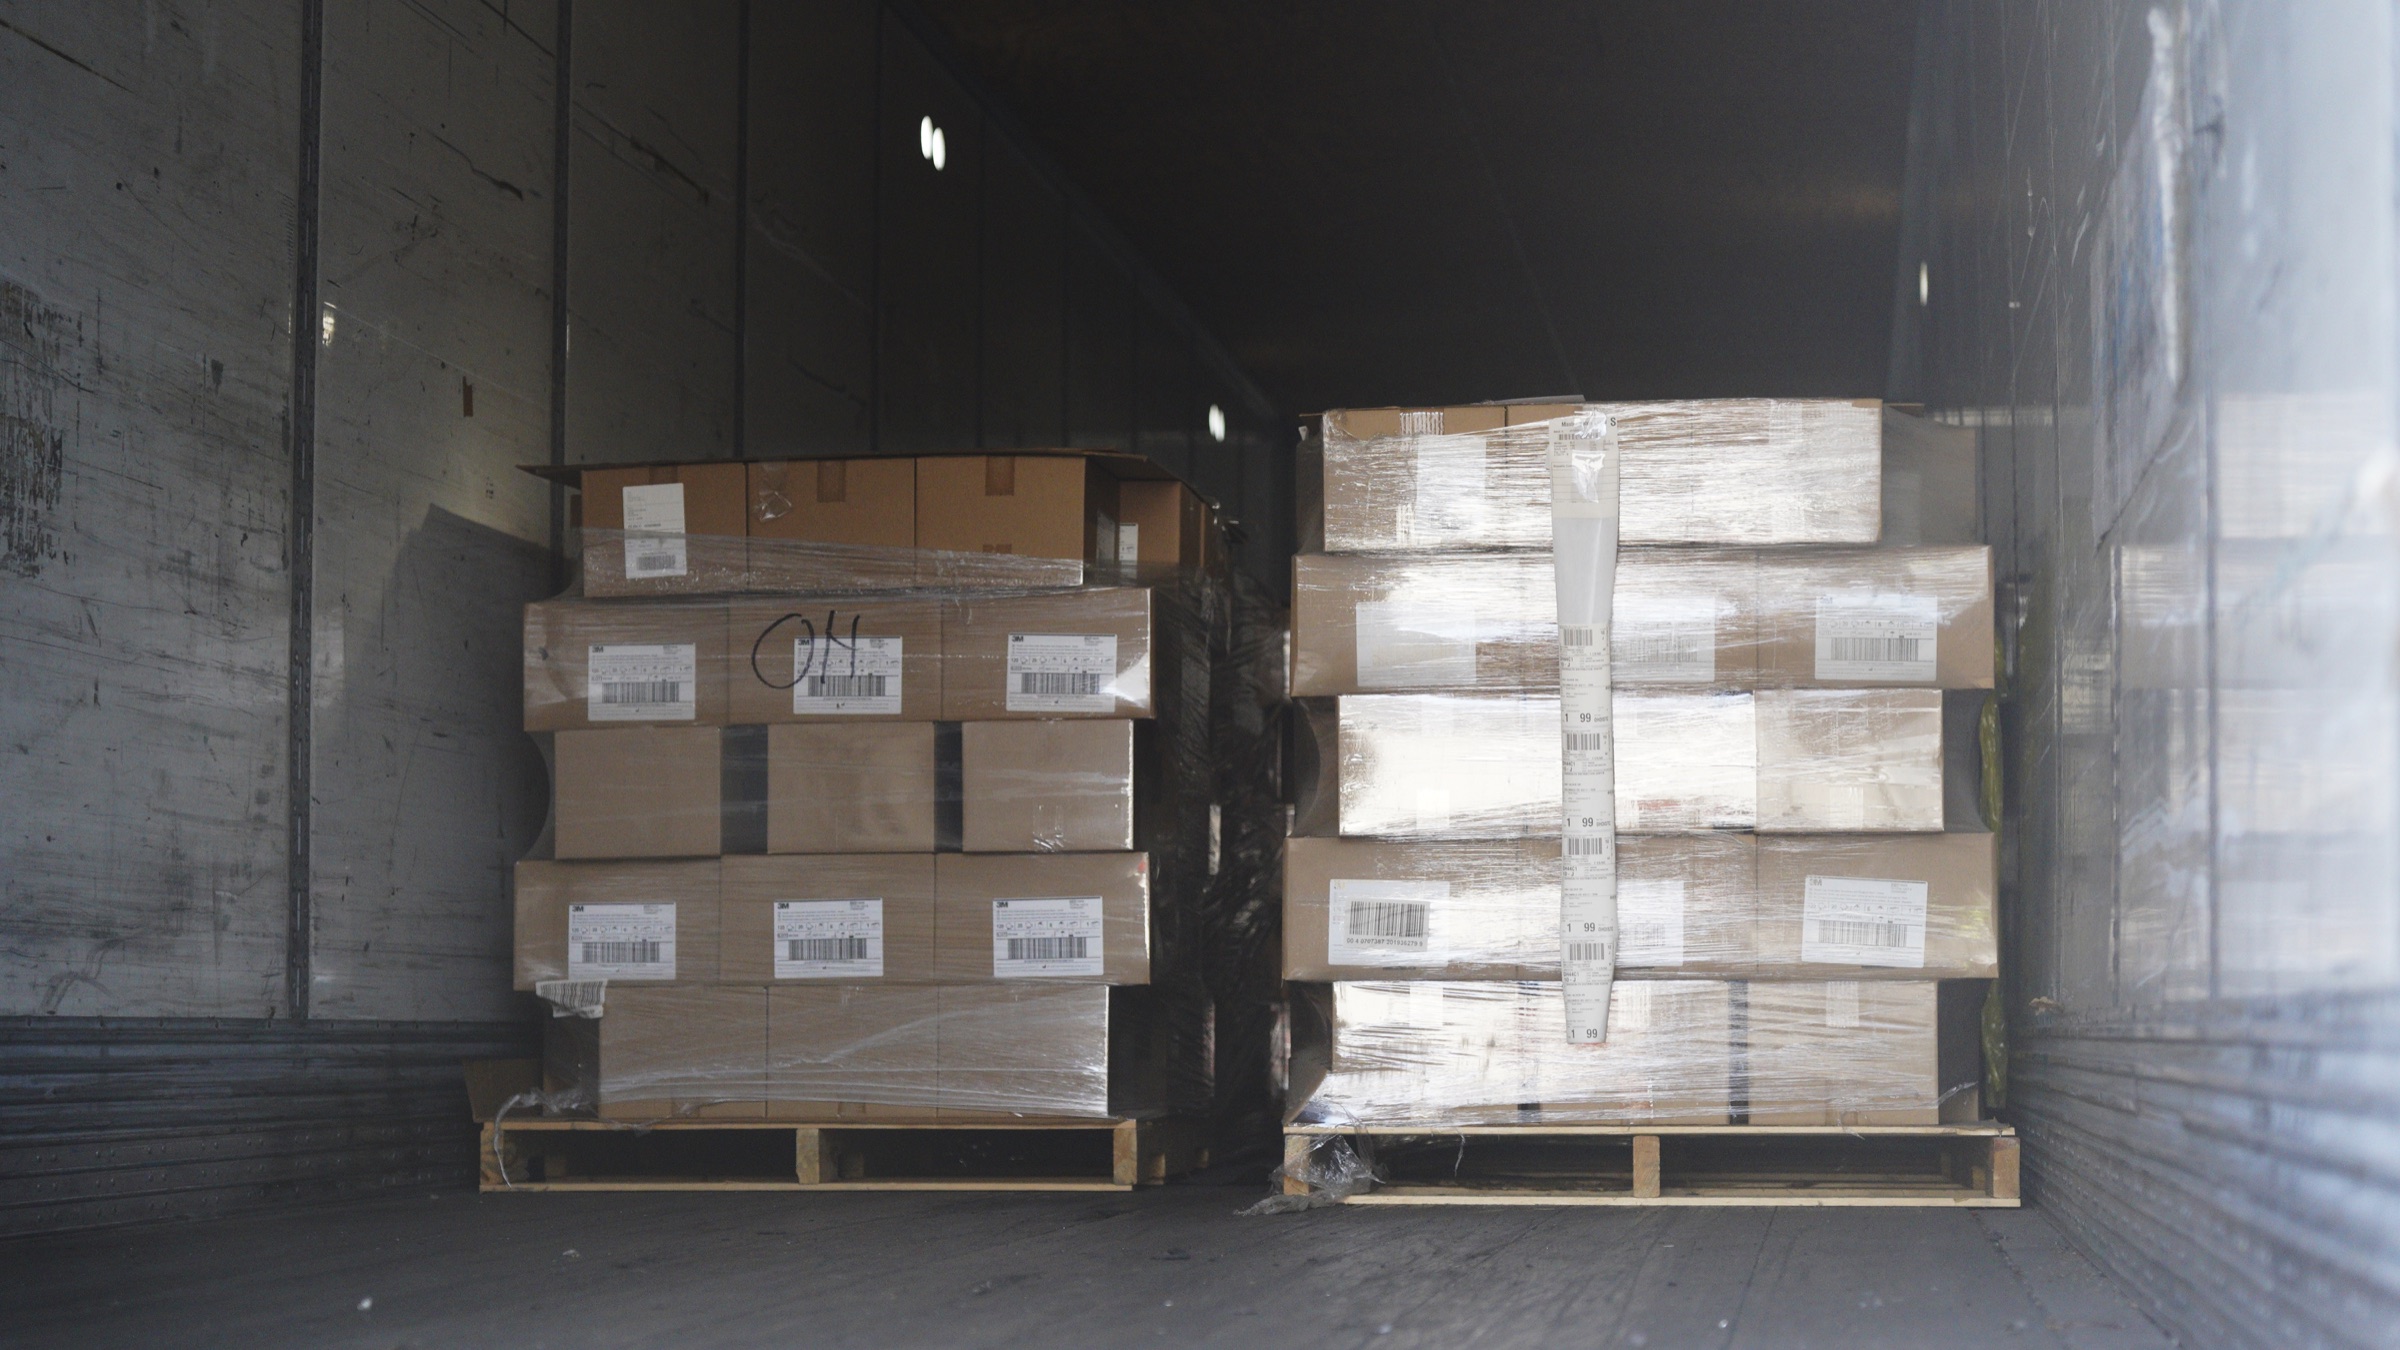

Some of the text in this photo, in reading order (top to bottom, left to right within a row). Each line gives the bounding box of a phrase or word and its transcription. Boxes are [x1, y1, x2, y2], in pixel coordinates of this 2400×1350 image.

[752, 610, 860, 689] OH
[1580, 712, 1591, 722] 99
[1582, 817, 1594, 827] 99
[1584, 923, 1595, 932] 99
[1586, 1029, 1597, 1038] 99
